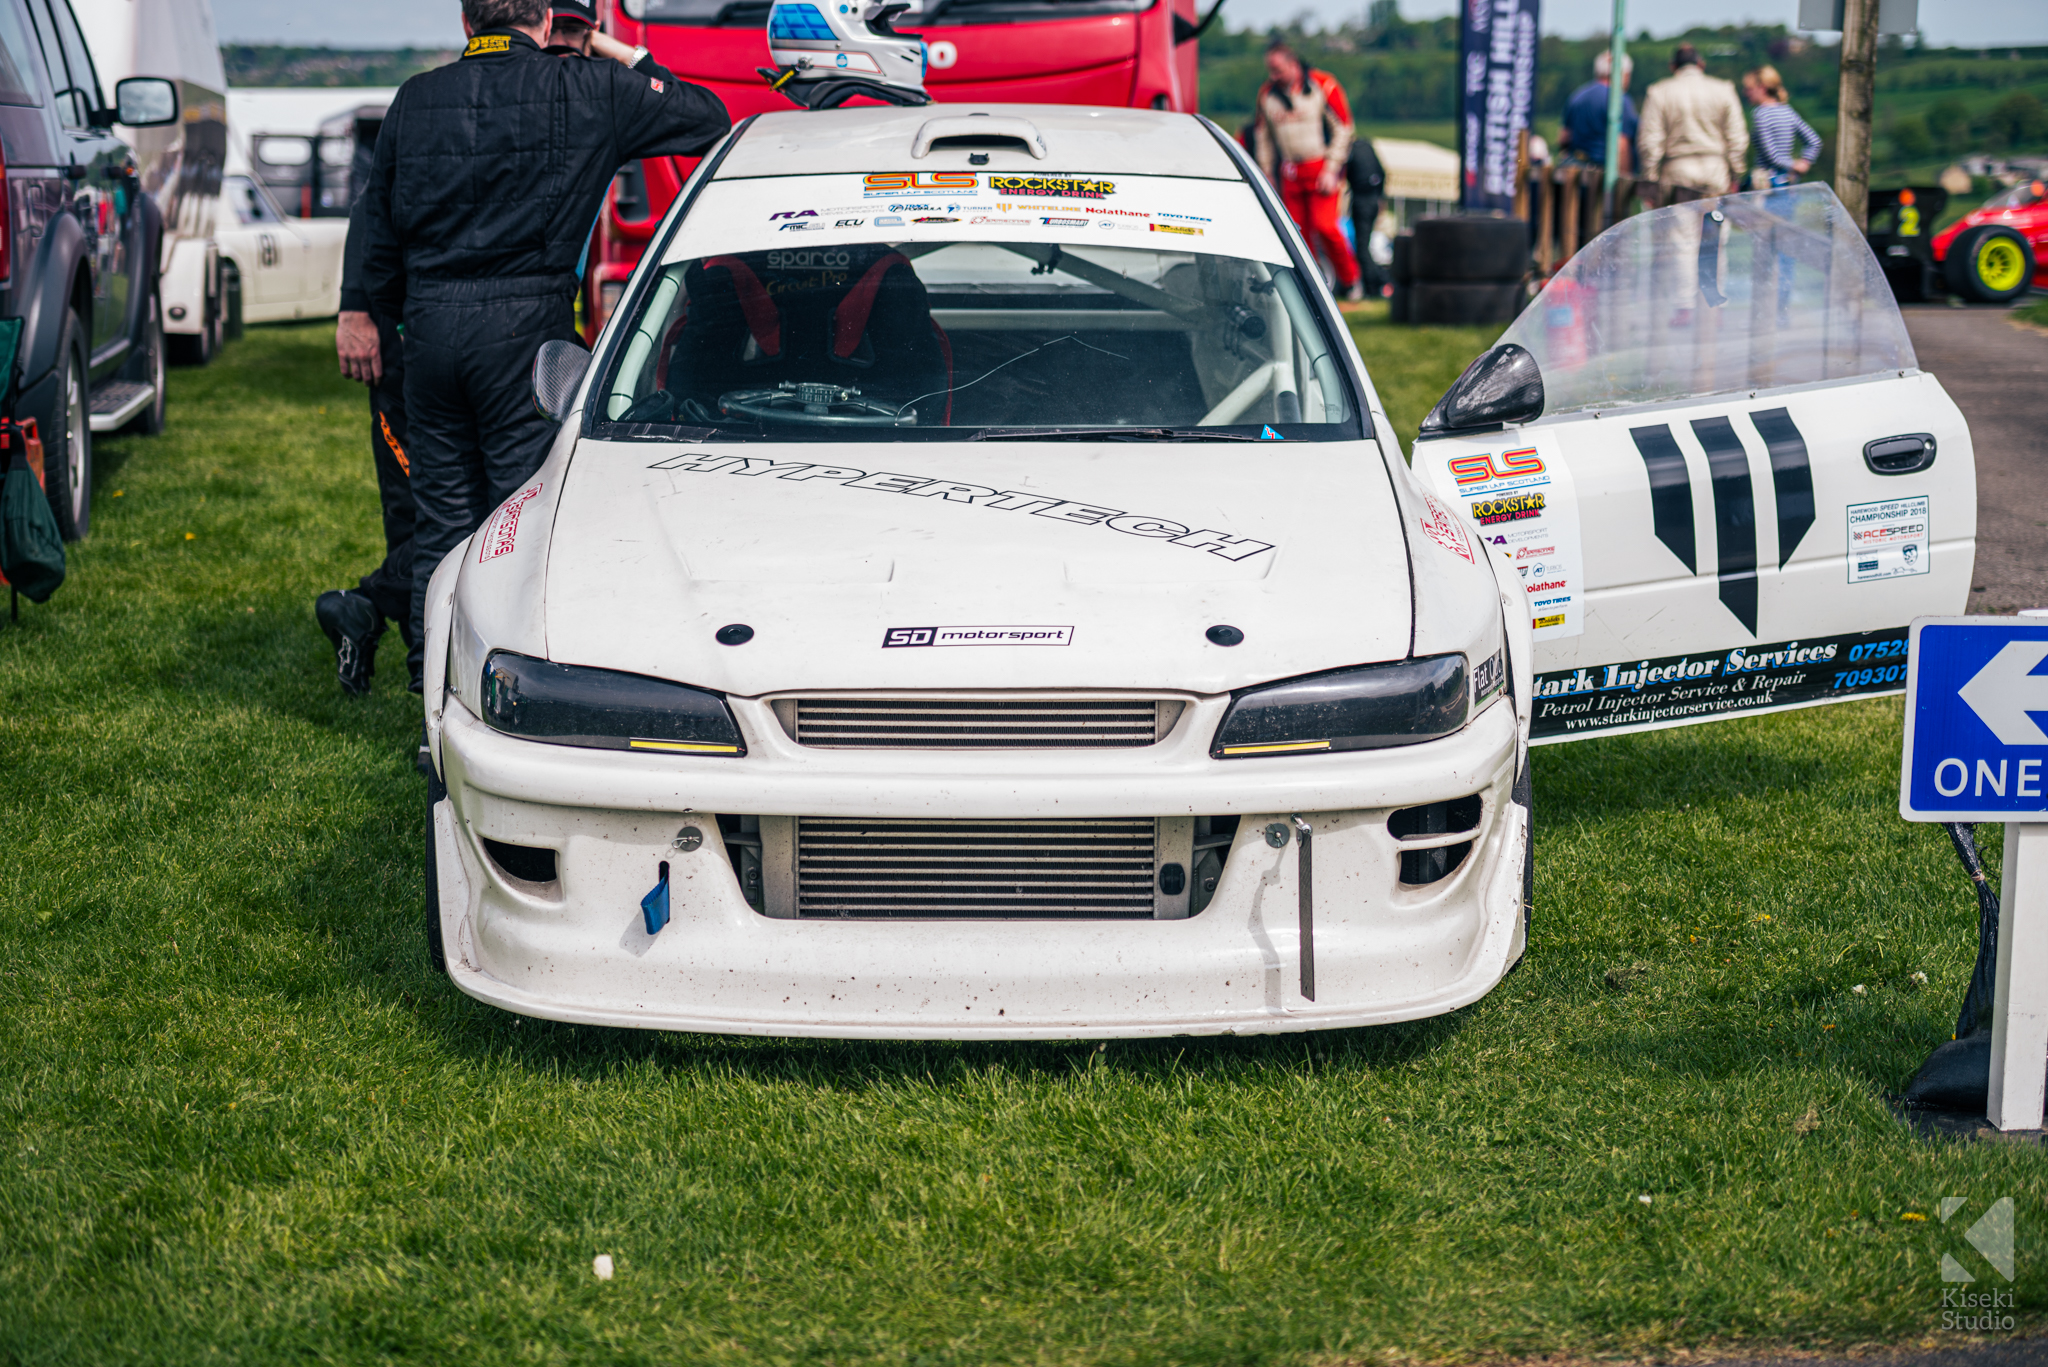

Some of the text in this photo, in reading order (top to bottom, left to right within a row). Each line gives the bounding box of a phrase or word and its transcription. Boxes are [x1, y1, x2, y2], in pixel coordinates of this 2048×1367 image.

[1504, 10, 1535, 197] PIONSHIP
[1484, 68, 1512, 195] BRITISH
[863, 173, 979, 191] SLS
[989, 176, 1115, 194] ROCKSTAR
[1000, 188, 1105, 199] ENERGY DRINK
[769, 209, 819, 221] RA
[1017, 204, 1081, 213] WHITELINE
[1085, 206, 1151, 218] Nolathane
[835, 217, 866, 227] ECU
[1897, 206, 1920, 237] 2
[767, 250, 850, 271] sparco
[766, 270, 848, 296] Circuit Pro
[1448, 446, 1546, 486] SLS
[1459, 475, 1551, 494] SUPER LAP SCOTLAND
[648, 453, 1275, 562] HYPERTECH
[1472, 493, 1545, 518] ROCKSTAR
[1850, 501, 1926, 515] HAREWOOD SPEED HILLCLIMB
[1480, 508, 1541, 526] ENERGY DRINK
[1850, 507, 1927, 524] CHAMPIONSHIP 2018
[1507, 527, 1548, 539] MOTORSPORT
[1508, 533, 1549, 544] DEVELOPMENTS
[1863, 524, 1924, 539] ACESPEED
[1889, 533, 1924, 542] MOTORSPORT
[1526, 580, 1566, 593] olathane
[1534, 599, 1551, 607] TOYO
[888, 628, 1065, 646] SD motorsport
[1473, 664, 1488, 693] Flat
[1533, 668, 1594, 698] tark
[1603, 660, 1719, 691] Injector
[1725, 641, 1839, 673] Services
[1834, 664, 1908, 689] 709307
[1539, 670, 1806, 718] Petrol Injector Service & Repair
[1565, 689, 1773, 730] www.starkinjectorservice.co.uk
[1934, 758, 2042, 797] ONE
